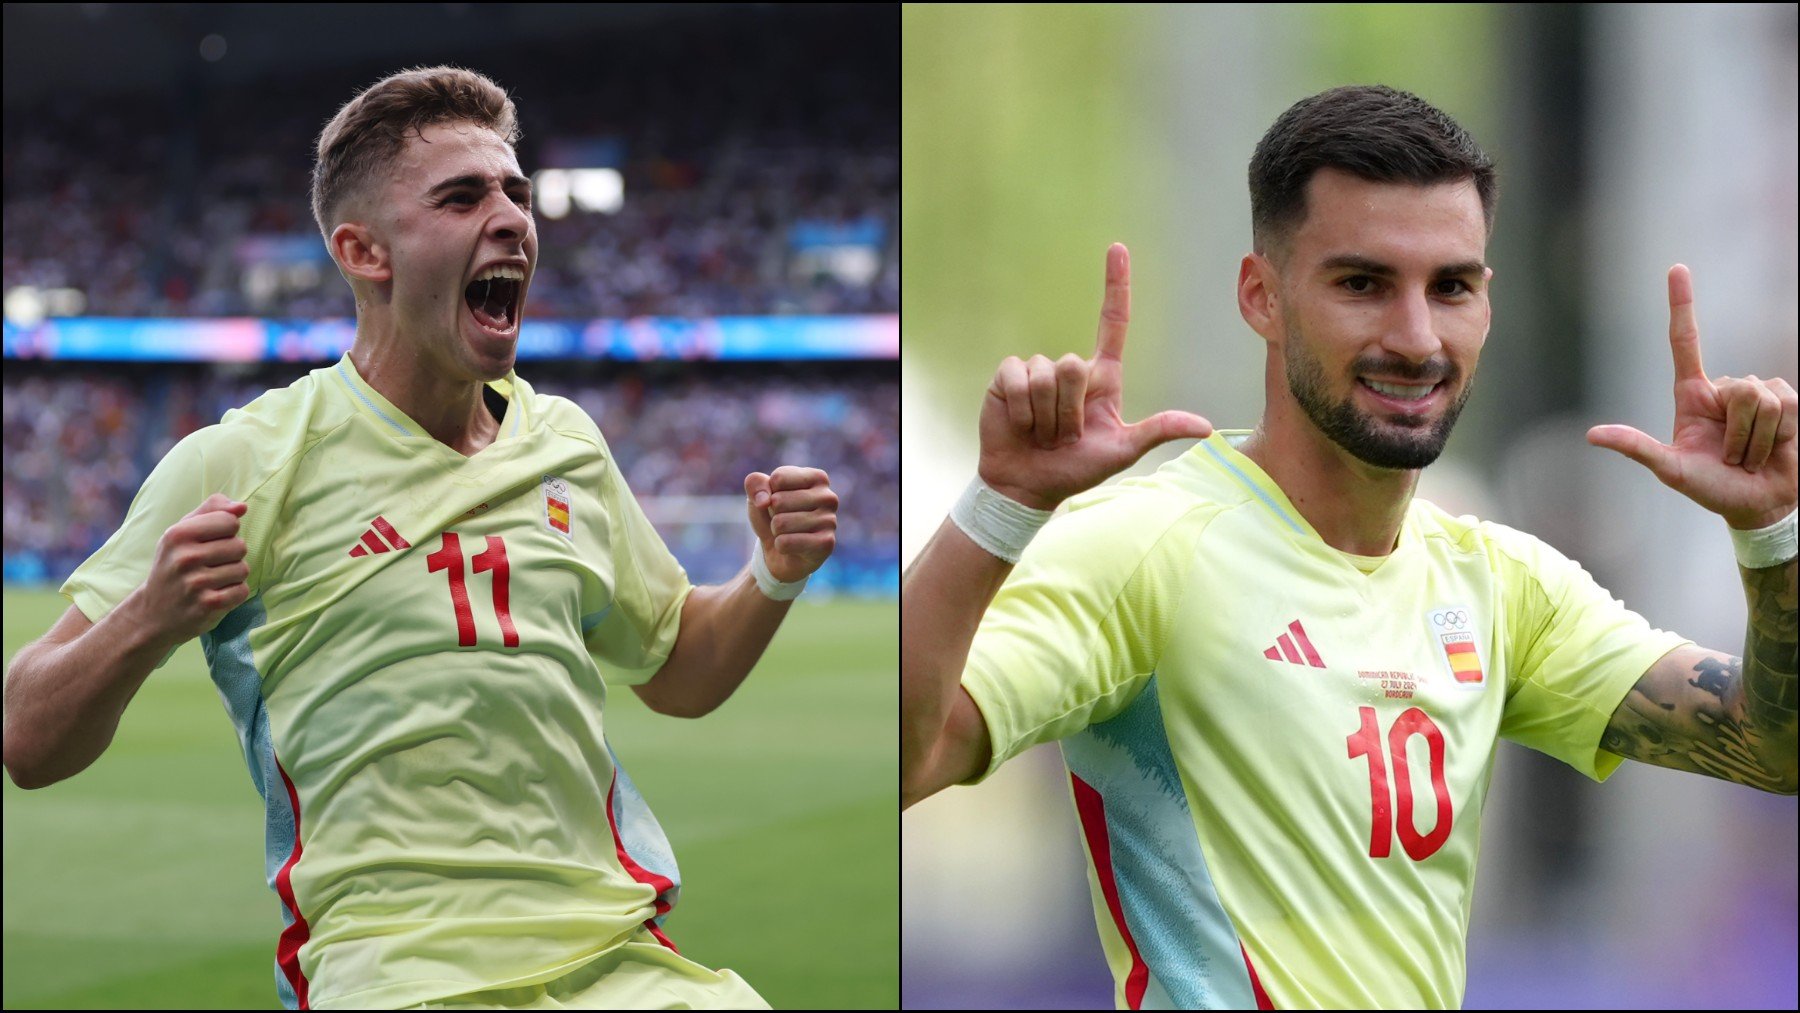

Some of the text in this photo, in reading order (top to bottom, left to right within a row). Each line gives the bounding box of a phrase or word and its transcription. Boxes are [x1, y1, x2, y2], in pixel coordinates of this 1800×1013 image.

[427, 532, 519, 648] 11
[1445, 633, 1470, 642] ESPAÑA
[1381, 680, 1388, 689] 27
[1346, 706, 1453, 861] 10
